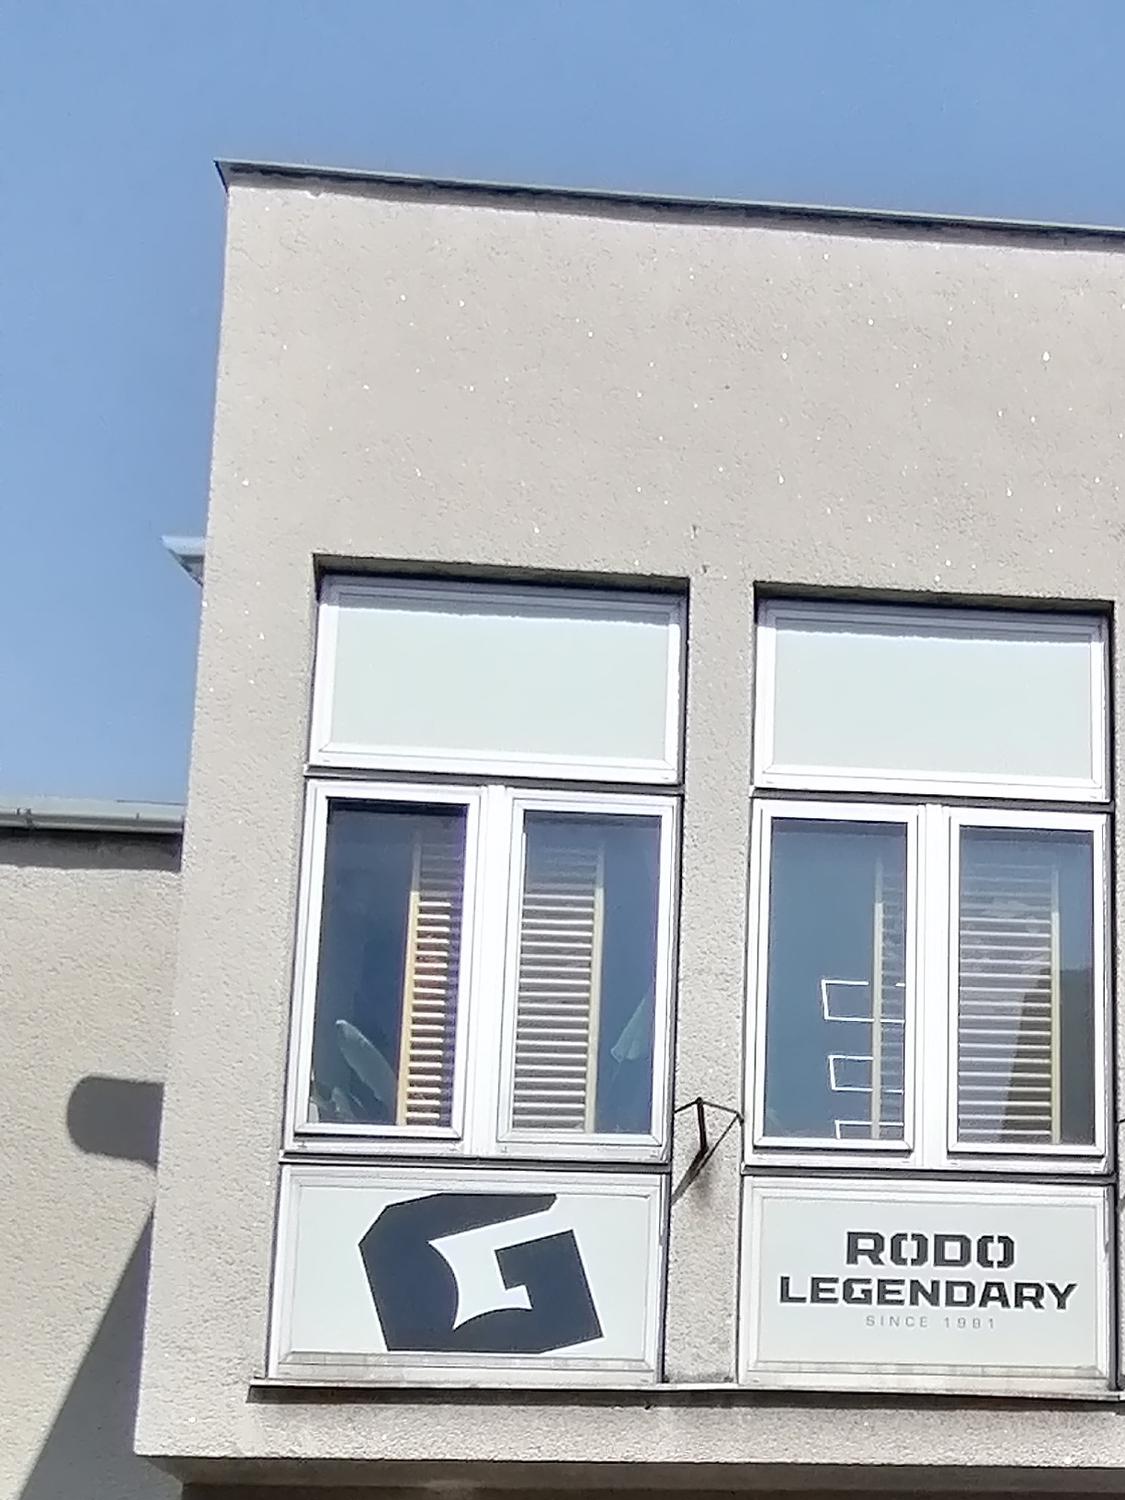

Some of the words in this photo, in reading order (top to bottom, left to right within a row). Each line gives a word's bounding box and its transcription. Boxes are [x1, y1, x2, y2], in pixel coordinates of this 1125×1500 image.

[846, 1231, 1015, 1268] RODO
[780, 1276, 1078, 1309] LEGENDARY
[866, 1315, 928, 1328] SINCE
[944, 1316, 995, 1329] 1991
